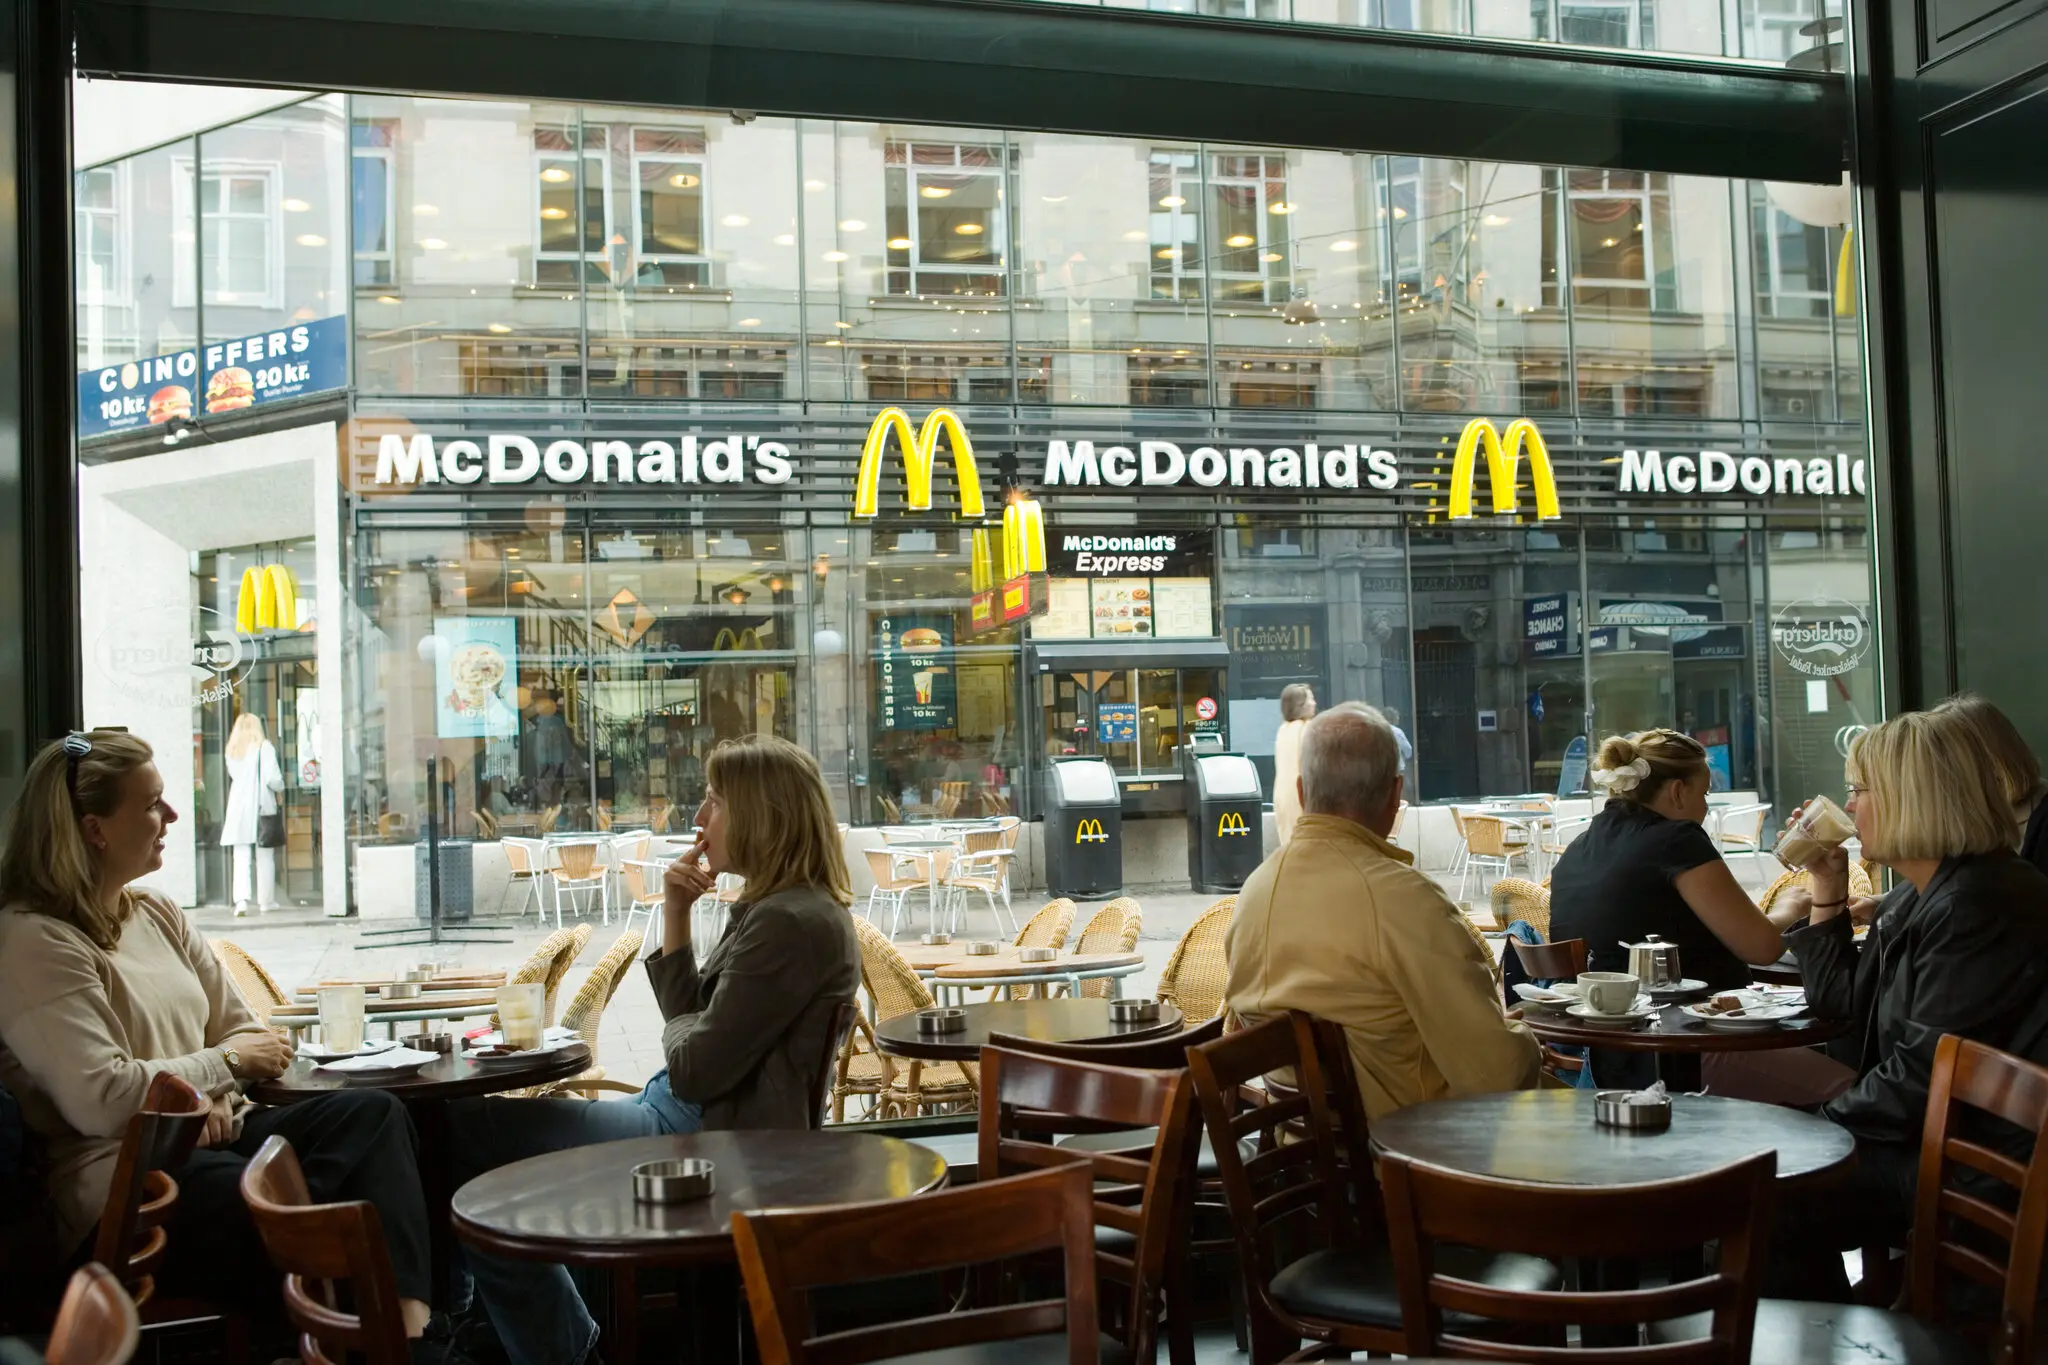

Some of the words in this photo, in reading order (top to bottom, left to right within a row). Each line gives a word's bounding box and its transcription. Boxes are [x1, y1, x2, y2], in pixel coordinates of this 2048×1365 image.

[375, 433, 793, 484] McDonald's
[1043, 439, 1399, 489] McDonald's
[1062, 535, 1177, 551] McDonald's
[1075, 551, 1166, 577] Express
